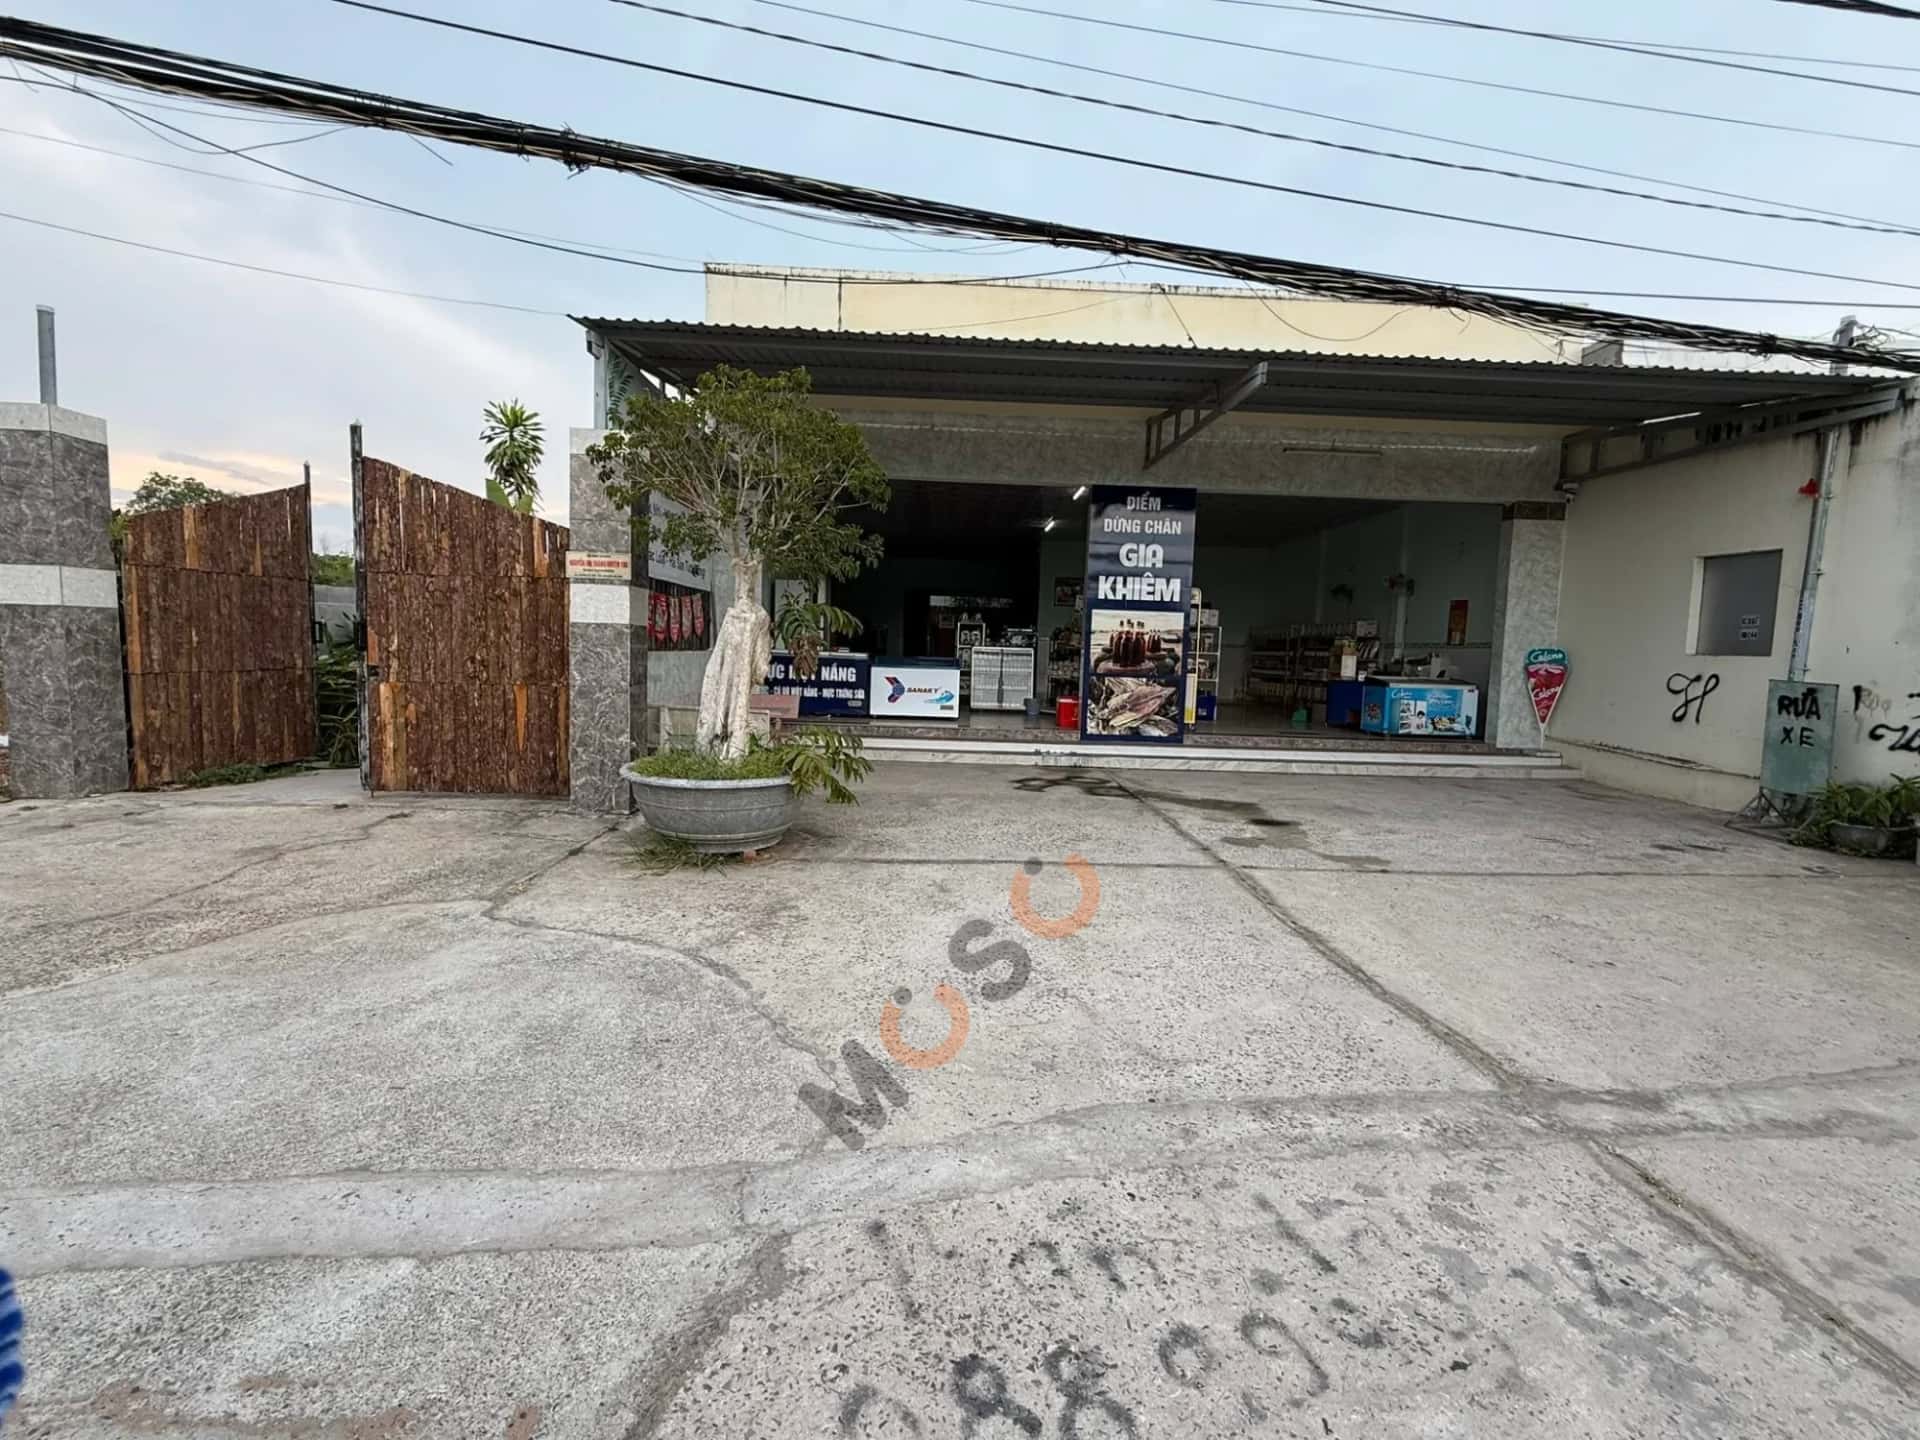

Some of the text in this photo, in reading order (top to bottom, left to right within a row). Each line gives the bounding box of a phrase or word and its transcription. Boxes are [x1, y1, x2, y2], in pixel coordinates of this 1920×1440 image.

[1144, 517, 1182, 535] CHÂN
[1118, 542, 1164, 568] GIA
[1097, 571, 1181, 602] KHIÊM
[767, 662, 785, 681] ỰC
[820, 662, 857, 682] NẮNG
[1780, 726, 1816, 747] XE
